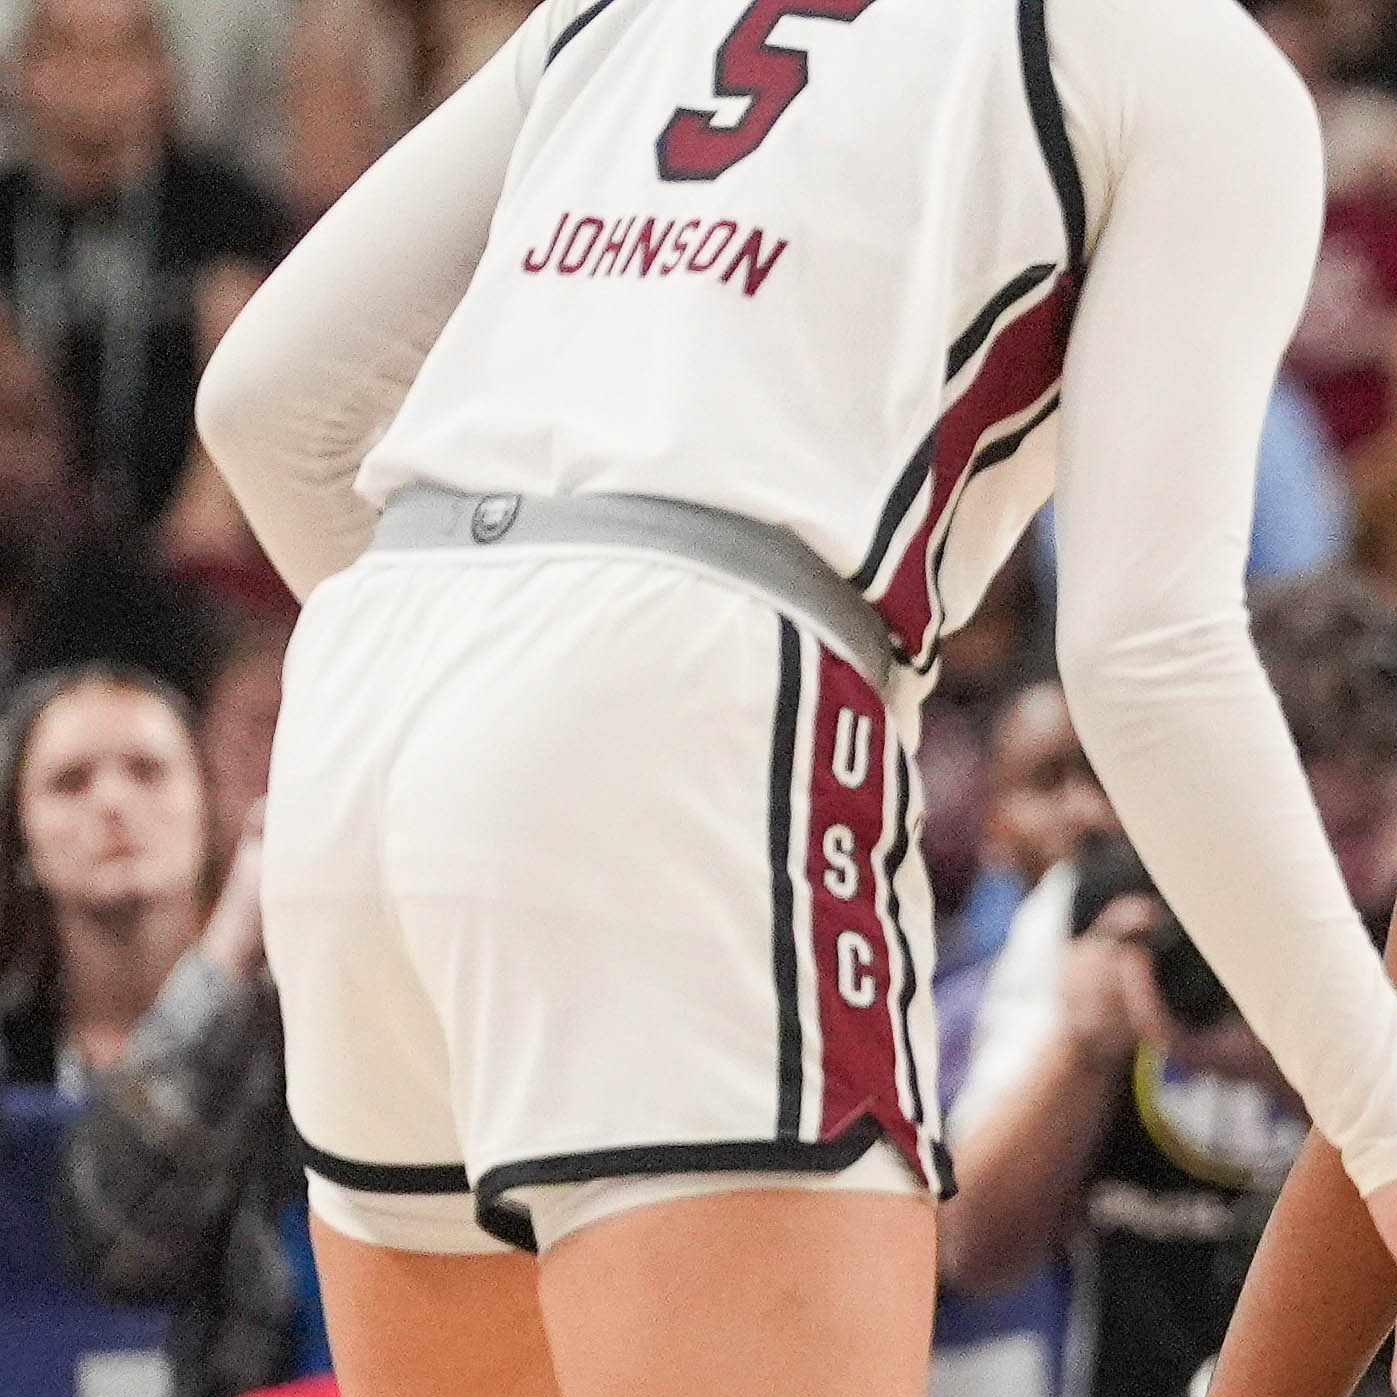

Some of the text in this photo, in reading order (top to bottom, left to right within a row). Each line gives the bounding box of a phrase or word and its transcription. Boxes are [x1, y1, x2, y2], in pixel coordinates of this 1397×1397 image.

[656, 0, 876, 182] 5
[522, 211, 790, 299] JOHNSON
[822, 706, 877, 1009] USC
